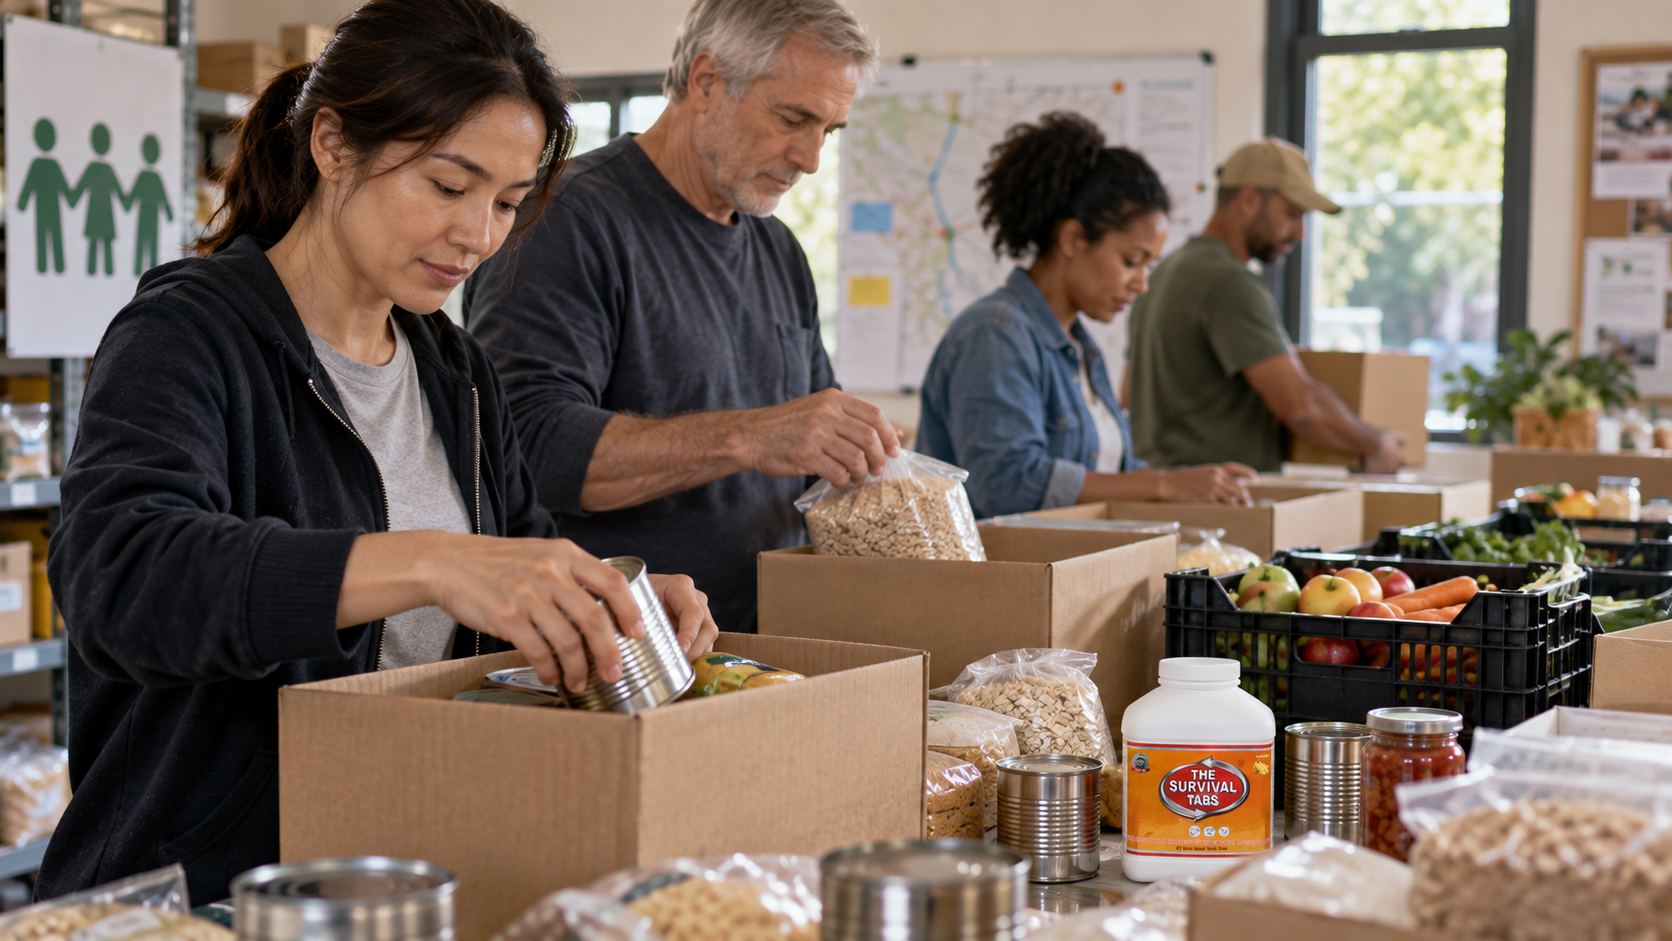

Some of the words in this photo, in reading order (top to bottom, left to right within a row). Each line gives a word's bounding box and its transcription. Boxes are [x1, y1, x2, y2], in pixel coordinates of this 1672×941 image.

[1191, 769, 1216, 780] THE
[1169, 780, 1237, 793] SURVIVAL
[1187, 794, 1219, 806] TABS
